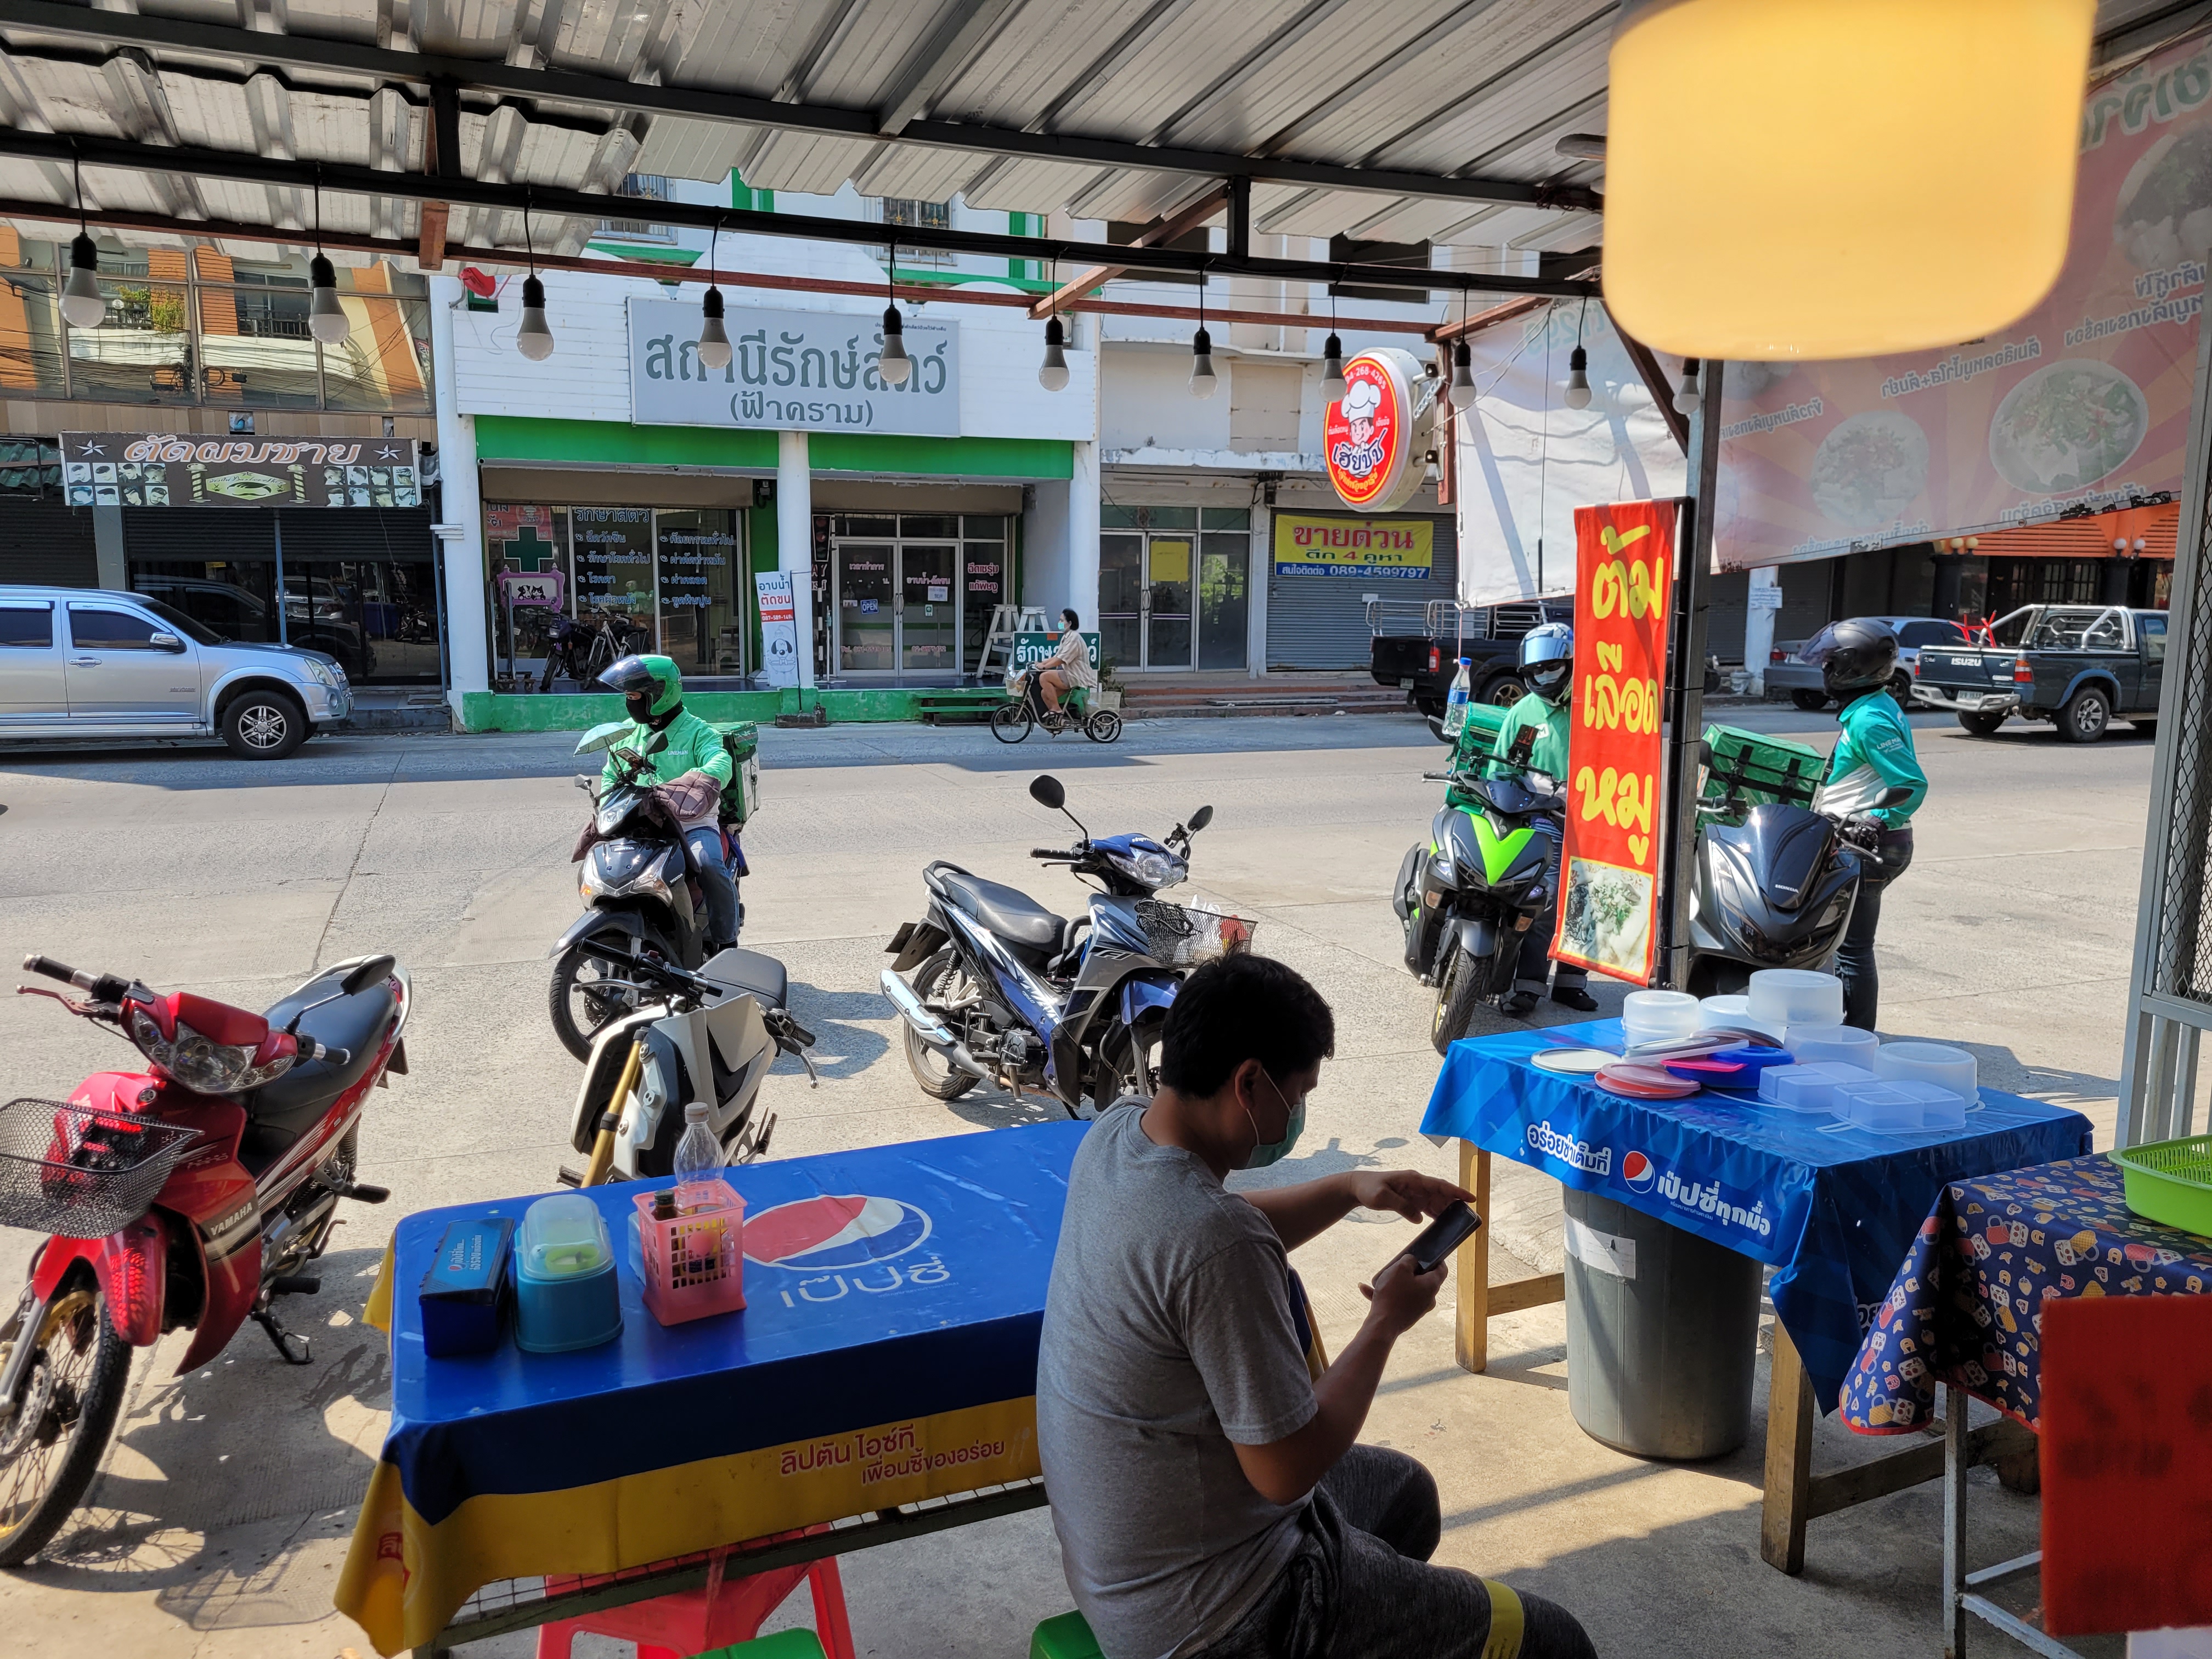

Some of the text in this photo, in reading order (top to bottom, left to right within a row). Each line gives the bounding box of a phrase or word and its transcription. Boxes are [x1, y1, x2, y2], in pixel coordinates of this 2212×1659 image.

[730, 390, 873, 427] (ฟ้าคราม)
[125, 435, 362, 464] ตัดผมชาย
[586, 530, 626, 543] ฉีดวัคซีน
[670, 531, 733, 545] ศัลยกรรมทั่วไป
[1294, 522, 1414, 549] ขายด่วน
[587, 549, 651, 564] รักษาโรคทั่วไป
[670, 552, 725, 565] ผ่าตัดทำหมัน
[1306, 549, 1402, 564] ตึก 4 คูหา
[968, 562, 999, 576] ฉีดเซรุ่ม
[1282, 564, 1425, 578] สนใจติดต่อ 089-4599797
[1593, 524, 1663, 620] ต้ม
[587, 572, 616, 584] โรคตา
[672, 573, 707, 585] ผ่าคลอด
[759, 574, 789, 590] อาบน้ำ
[969, 580, 998, 593] แก้พิษงู
[588, 592, 636, 605] โรคผิวหนัง
[672, 594, 711, 608] ขูดหินปูน
[761, 593, 791, 605] ตัดขน
[862, 603, 877, 612] OPEN
[1951, 657, 1982, 667] ISUZU
[1576, 766, 1653, 865] หมู
[334, 1062, 385, 1127] SPARK
[1527, 1121, 1611, 1175] อร่อยซ่าเต็มที่
[1657, 1170, 1770, 1235] เป๊ปซี่ทุกมื้อ
[210, 1203, 253, 1235] YAMAHA
[780, 1256, 951, 1308] เป๊ปซี่
[780, 1424, 915, 1475] ลิปตัน ไอซ์ที
[861, 1440, 1005, 1485] เพื่อนซี้ของอร่อย
